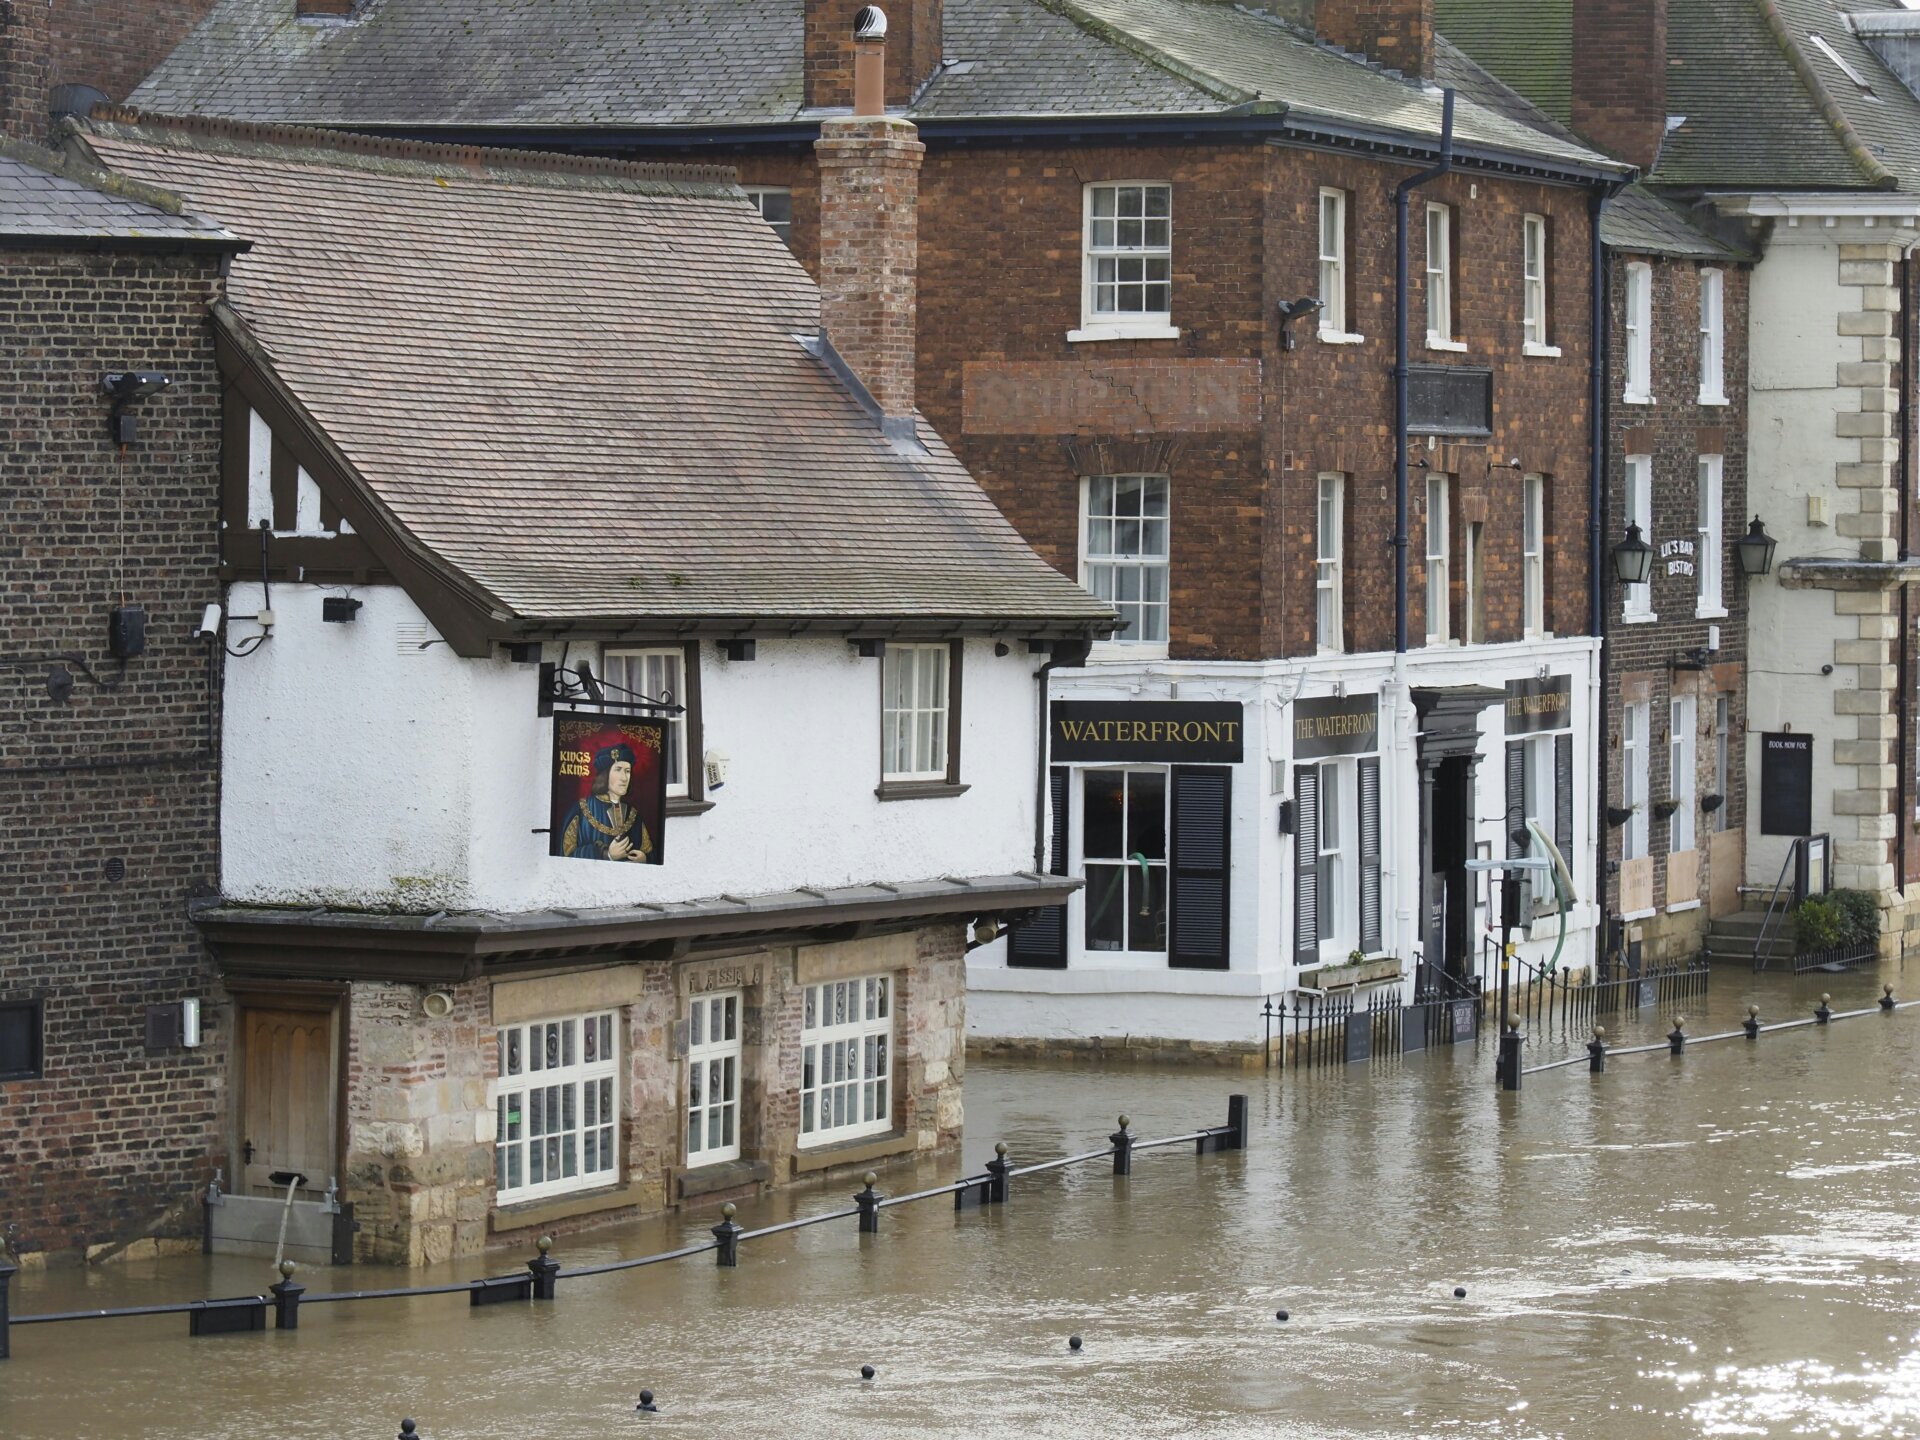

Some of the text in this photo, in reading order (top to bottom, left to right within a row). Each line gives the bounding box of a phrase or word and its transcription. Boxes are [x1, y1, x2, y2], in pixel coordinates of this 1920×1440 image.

[1678, 540, 1694, 557] BAR
[1667, 560, 1694, 577] BISTRO
[1506, 692, 1571, 717] THE WATERFRONT
[1059, 721, 1239, 742] WATERFRONT
[1295, 712, 1377, 739] THE WATERFRONT
[1768, 740, 1807, 750] BOOK NOW FOR
[559, 750, 591, 764] KINGS
[559, 764, 590, 777] ARMS
